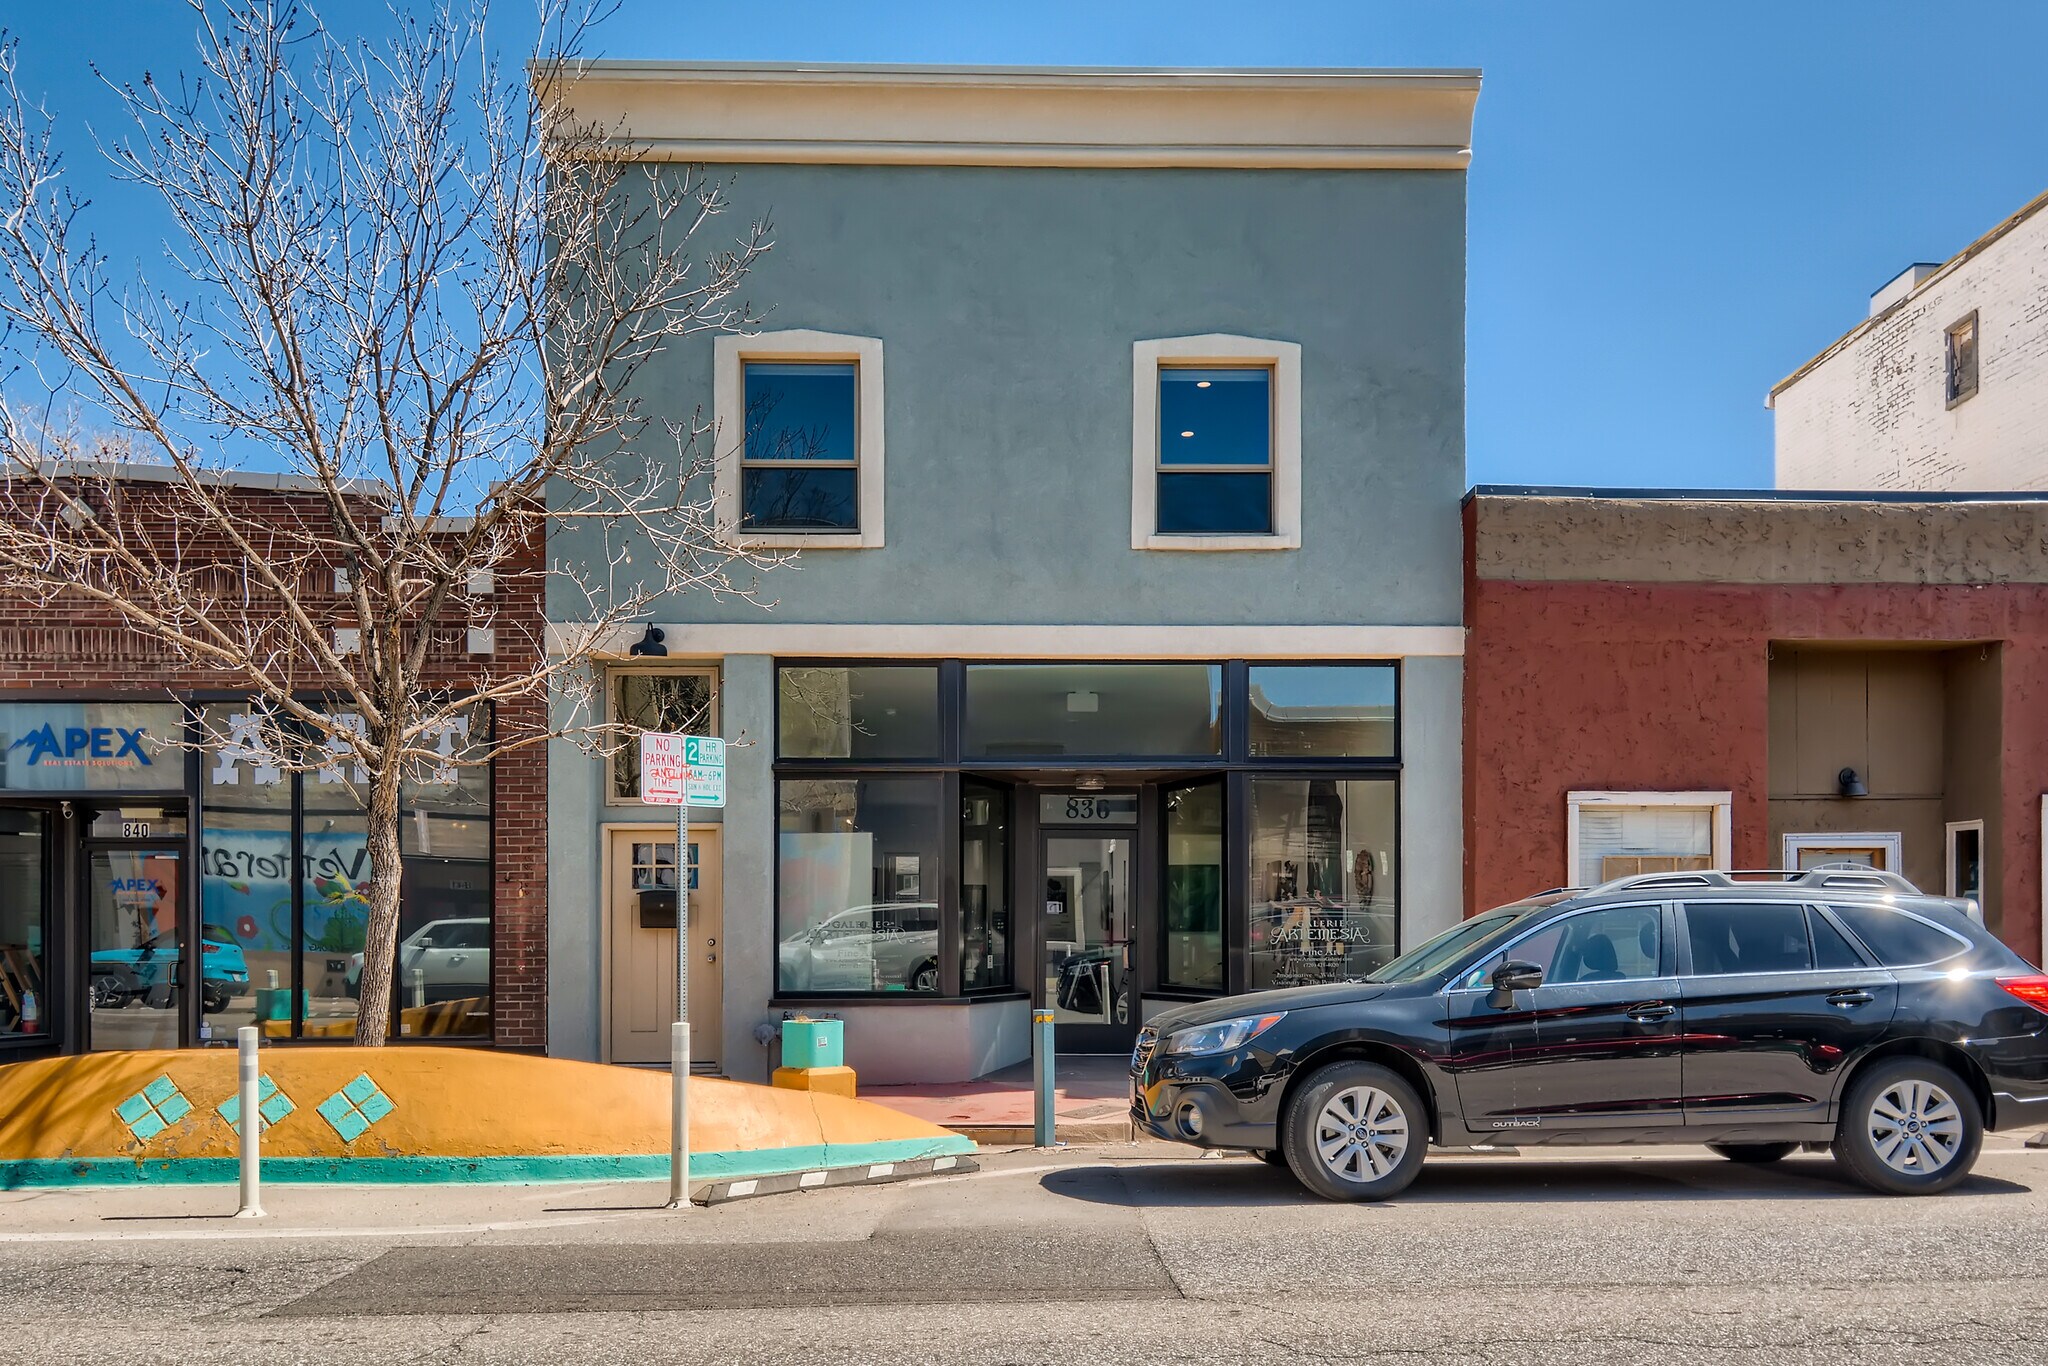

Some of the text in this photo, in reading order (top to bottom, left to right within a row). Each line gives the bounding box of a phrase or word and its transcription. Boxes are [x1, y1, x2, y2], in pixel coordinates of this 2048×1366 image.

[9, 722, 153, 766] APEX
[213, 713, 469, 785] ART
[655, 738, 670, 751] NO
[688, 742, 717, 761] 2 HR
[645, 752, 681, 768] PARKING
[700, 753, 722, 763] PARKING
[655, 767, 671, 777] ANY
[654, 778, 673, 788] TIME
[1065, 799, 1110, 819] 836
[123, 823, 149, 837] 840
[107, 876, 160, 895] APEX
[1270, 926, 1371, 944] ARTEMESIA
[1492, 1120, 1540, 1128] OUTBACK
